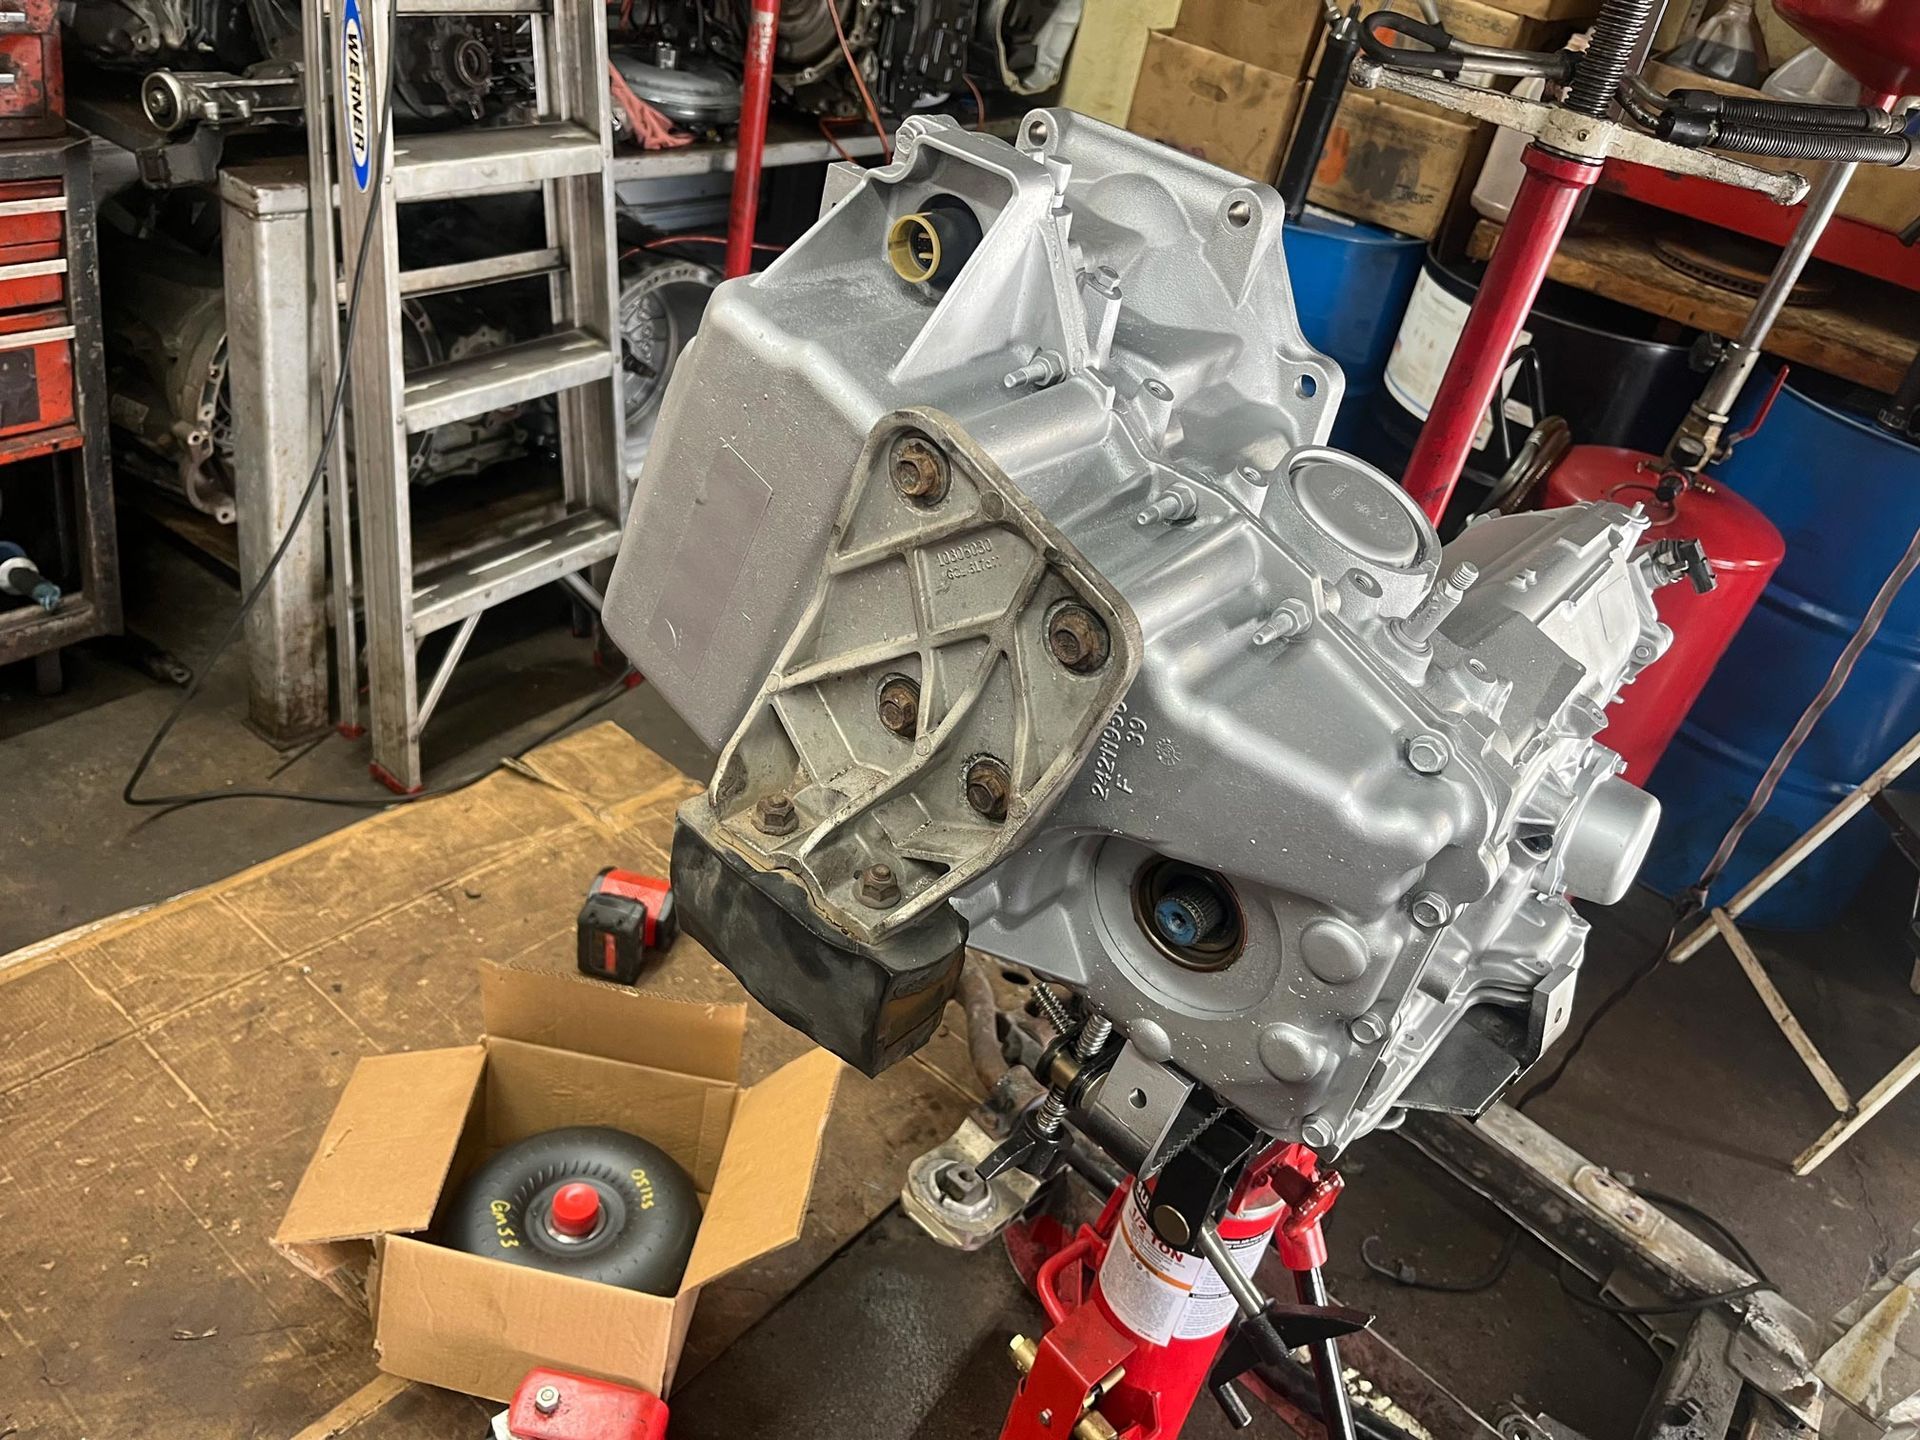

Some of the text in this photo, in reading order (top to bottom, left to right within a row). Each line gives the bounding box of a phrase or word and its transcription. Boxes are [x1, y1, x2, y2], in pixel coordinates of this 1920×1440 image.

[347, 33, 365, 151] WERNER
[1115, 716, 1148, 795] F 39
[1135, 1180, 1152, 1210] SU
[1130, 1208, 1148, 1234] 1/2
[1150, 1233, 1185, 1264] TON
